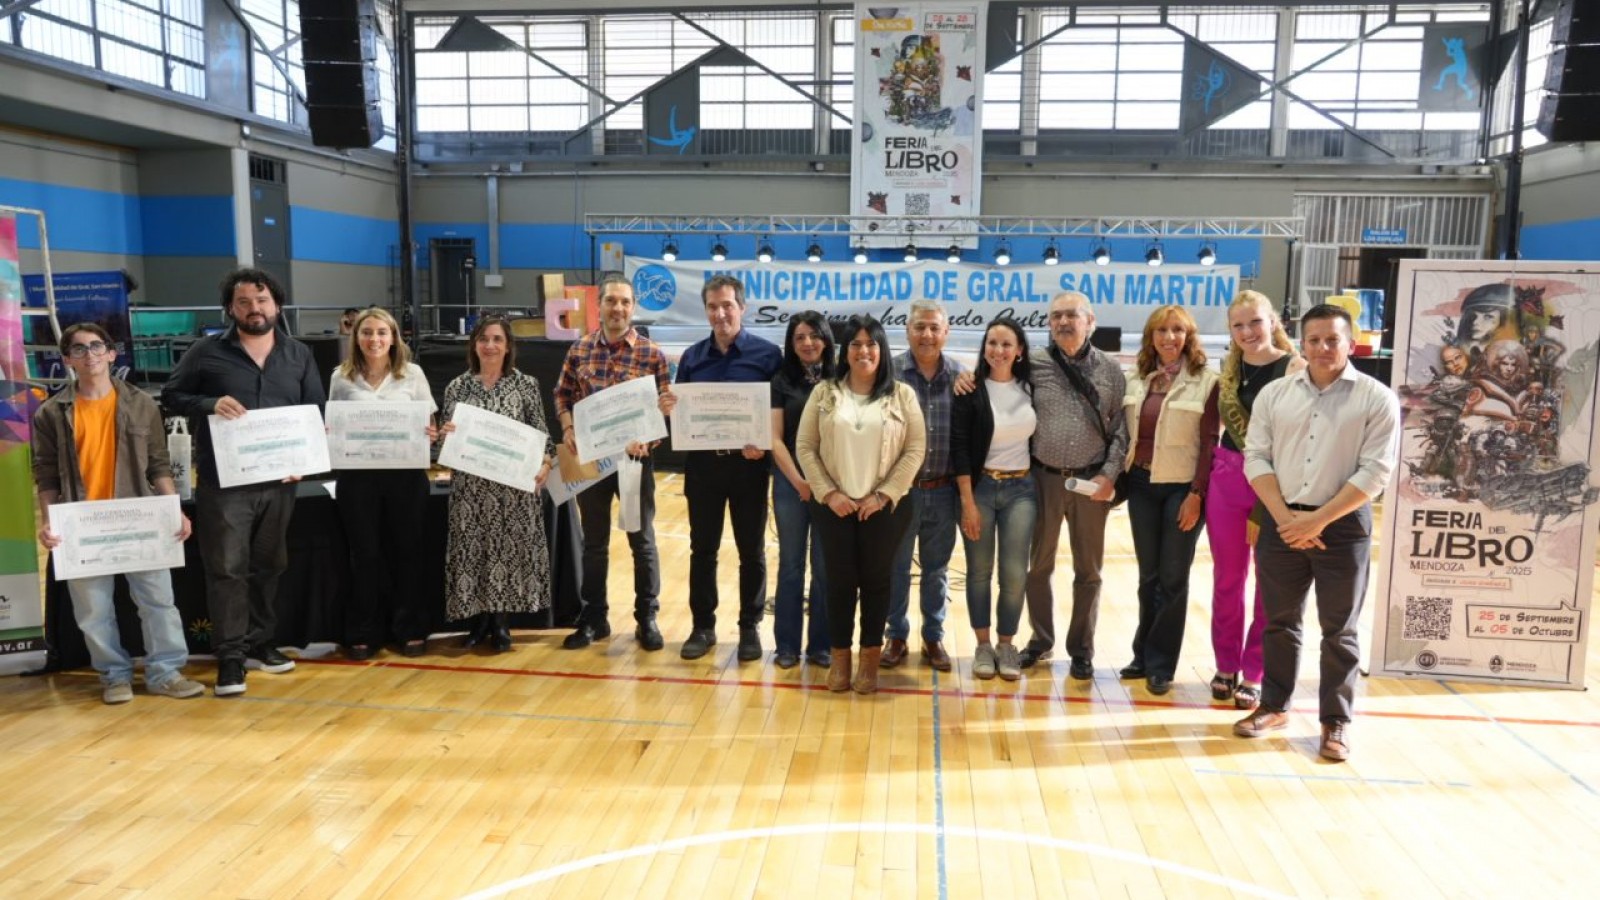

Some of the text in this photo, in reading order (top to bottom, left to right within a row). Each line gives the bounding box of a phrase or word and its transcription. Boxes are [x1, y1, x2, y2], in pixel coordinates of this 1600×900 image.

[885, 137, 928, 149] FERIA
[885, 151, 958, 173] LIBRO
[704, 269, 1235, 306] NICIPALIDAD DE GRAL. SAN MARTÍN
[1412, 509, 1506, 534] FERIA DEL
[1410, 531, 1533, 567] LIBRO
[1410, 560, 1532, 576] MENDOZA 2025
[1480, 611, 1496, 621] 25
[1517, 612, 1575, 624] SEPTIEMBRE
[1490, 624, 1508, 634] 05
[1512, 627, 1524, 635] DE
[1529, 626, 1574, 637] OCTUBRE
